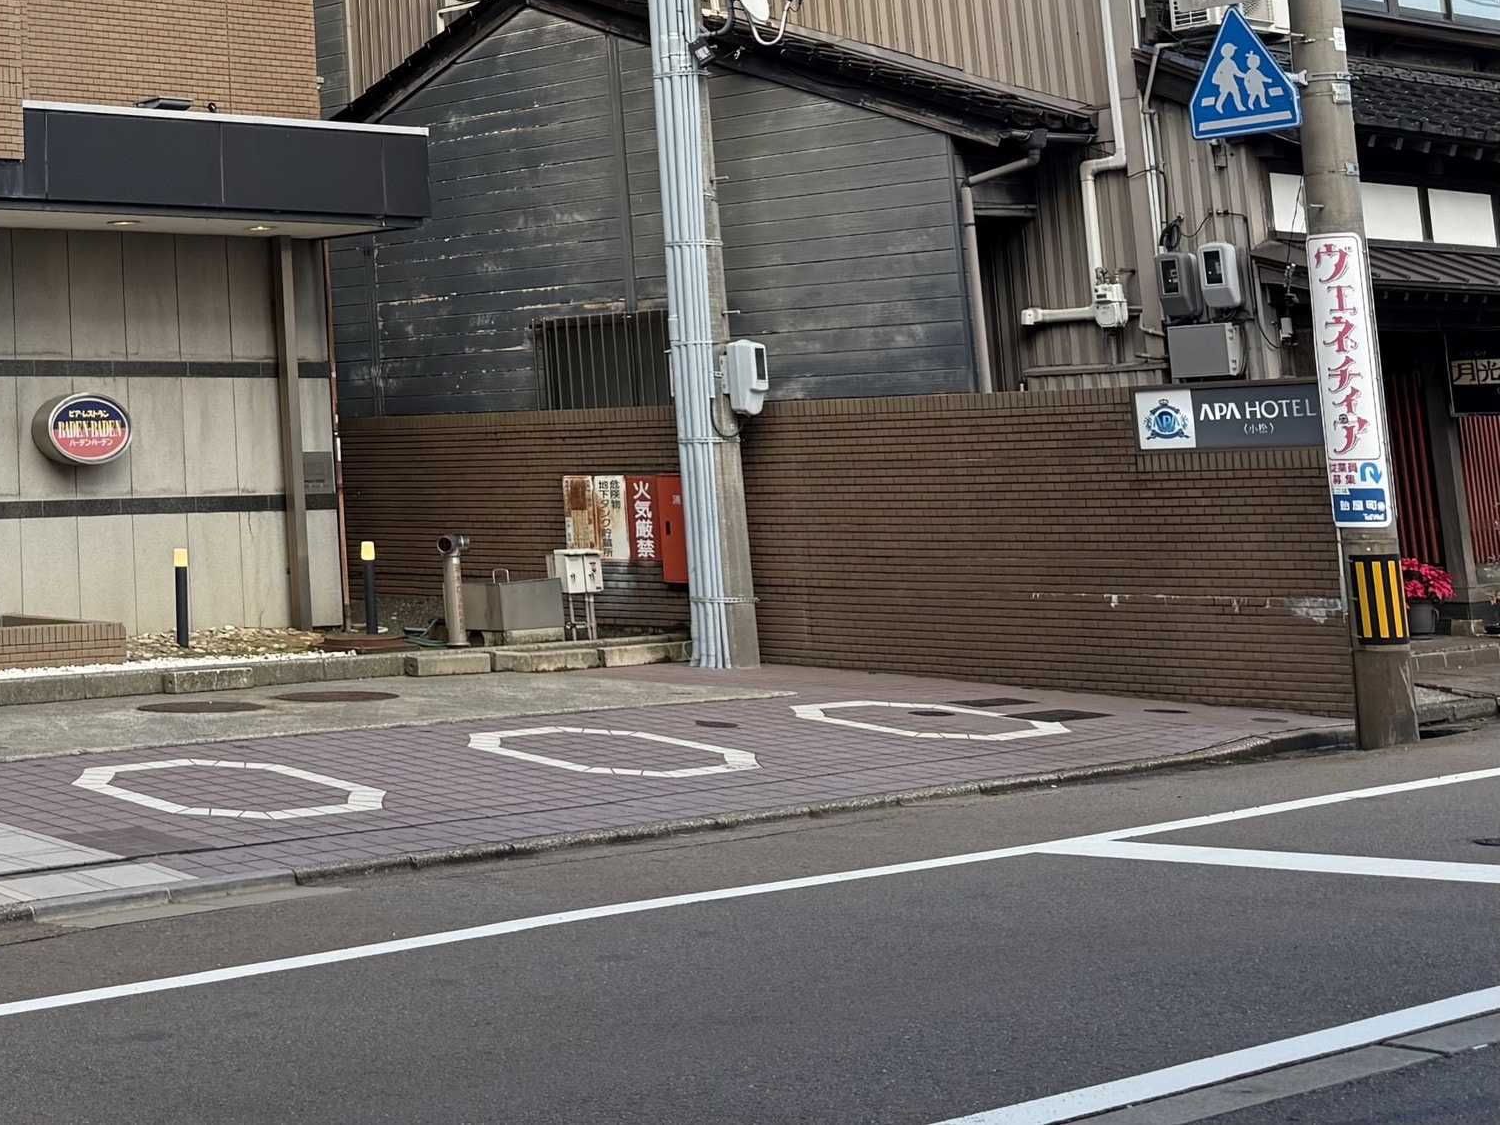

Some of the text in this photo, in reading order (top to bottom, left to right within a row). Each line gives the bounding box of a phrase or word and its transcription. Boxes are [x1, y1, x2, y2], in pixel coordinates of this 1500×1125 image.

[1199, 398, 1317, 421] APA HOTEL
[632, 480, 655, 558] 火気厳禁
